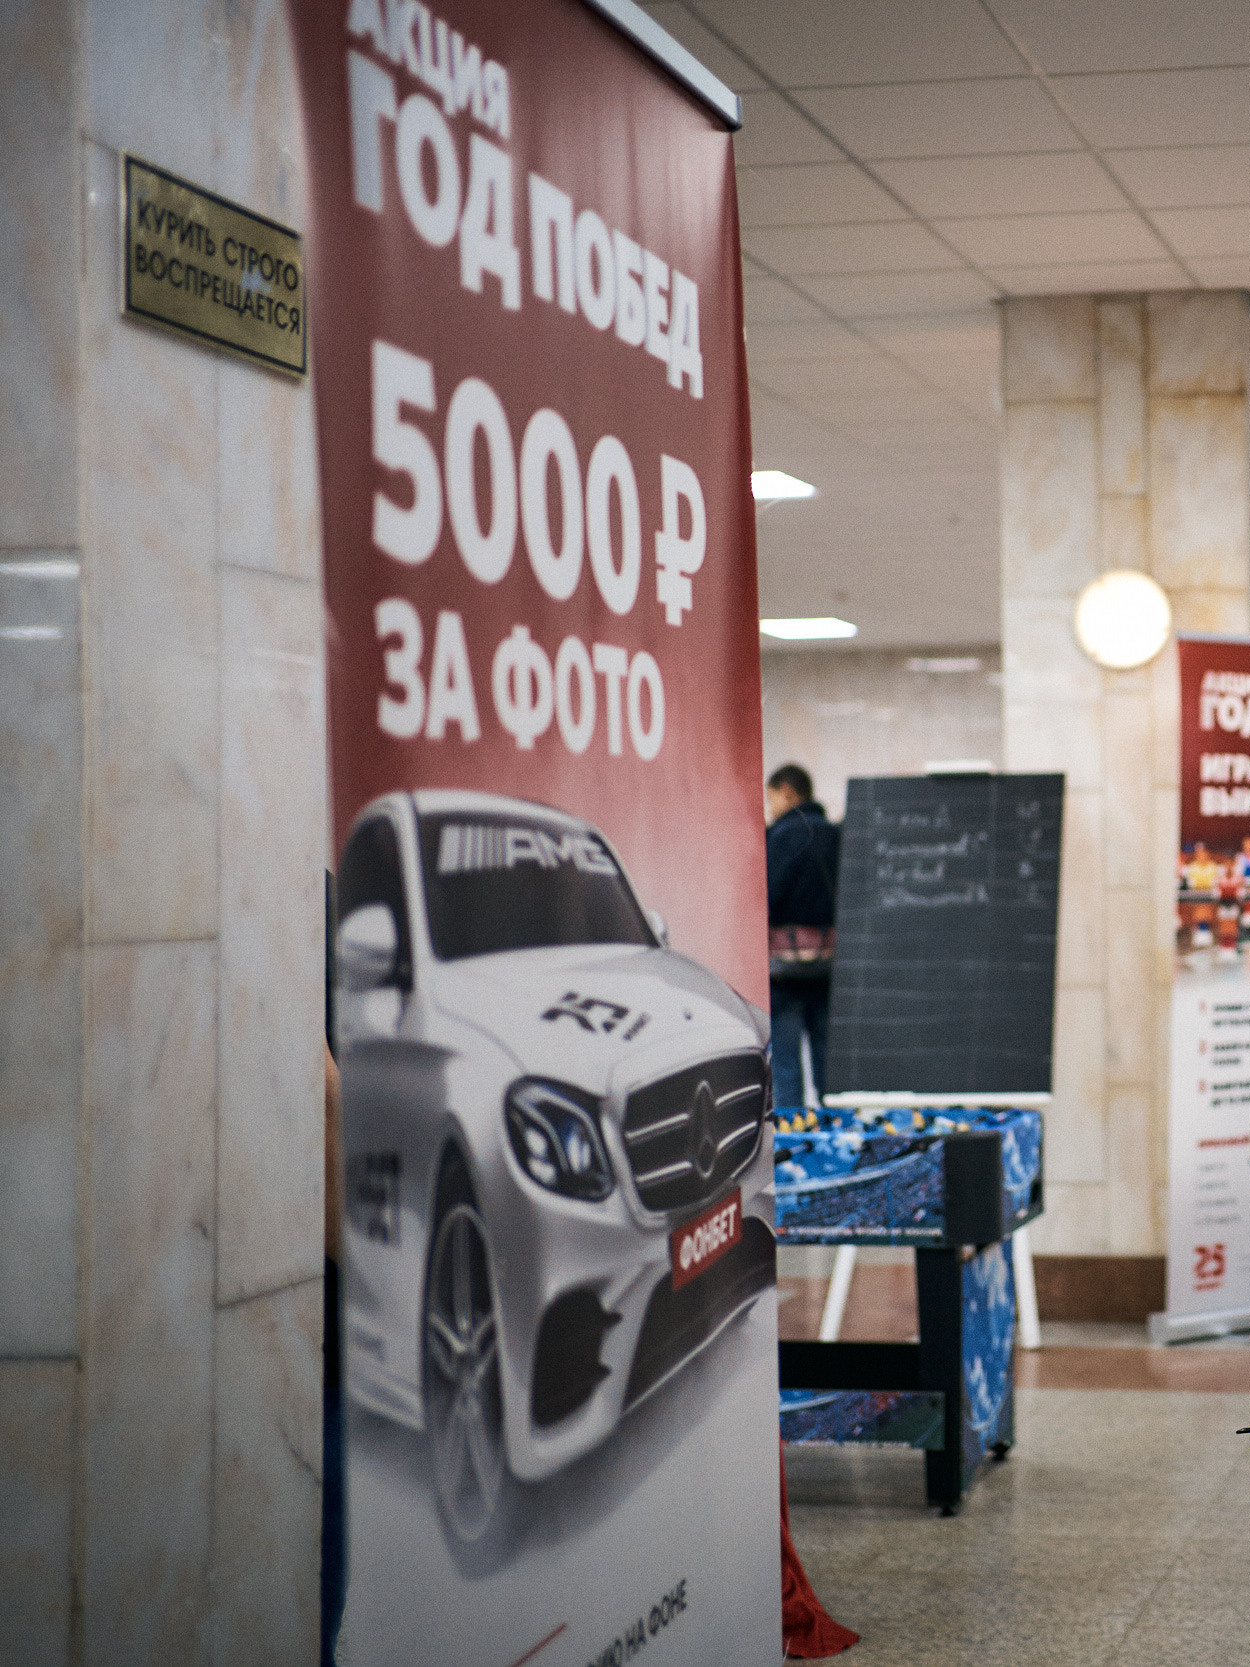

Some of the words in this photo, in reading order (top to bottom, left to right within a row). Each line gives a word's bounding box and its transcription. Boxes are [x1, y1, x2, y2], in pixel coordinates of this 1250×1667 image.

[136, 196, 216, 257] КУРИТЬ
[223, 237, 298, 291] СТРОГО
[347, 49, 521, 311] ГОД
[528, 172, 703, 399] ПОБЕД
[135, 244, 300, 335] ВОСПРЕЩАЕТСЯ
[371, 339, 641, 616] 5000
[375, 598, 481, 742] ЗА
[491, 625, 665, 761] ФОТО
[504, 828, 617, 876] AMG
[679, 1202, 738, 1271] ФОНБЕТ
[625, 1617, 647, 1662] НА
[648, 1578, 687, 1636] ФОНЕ
